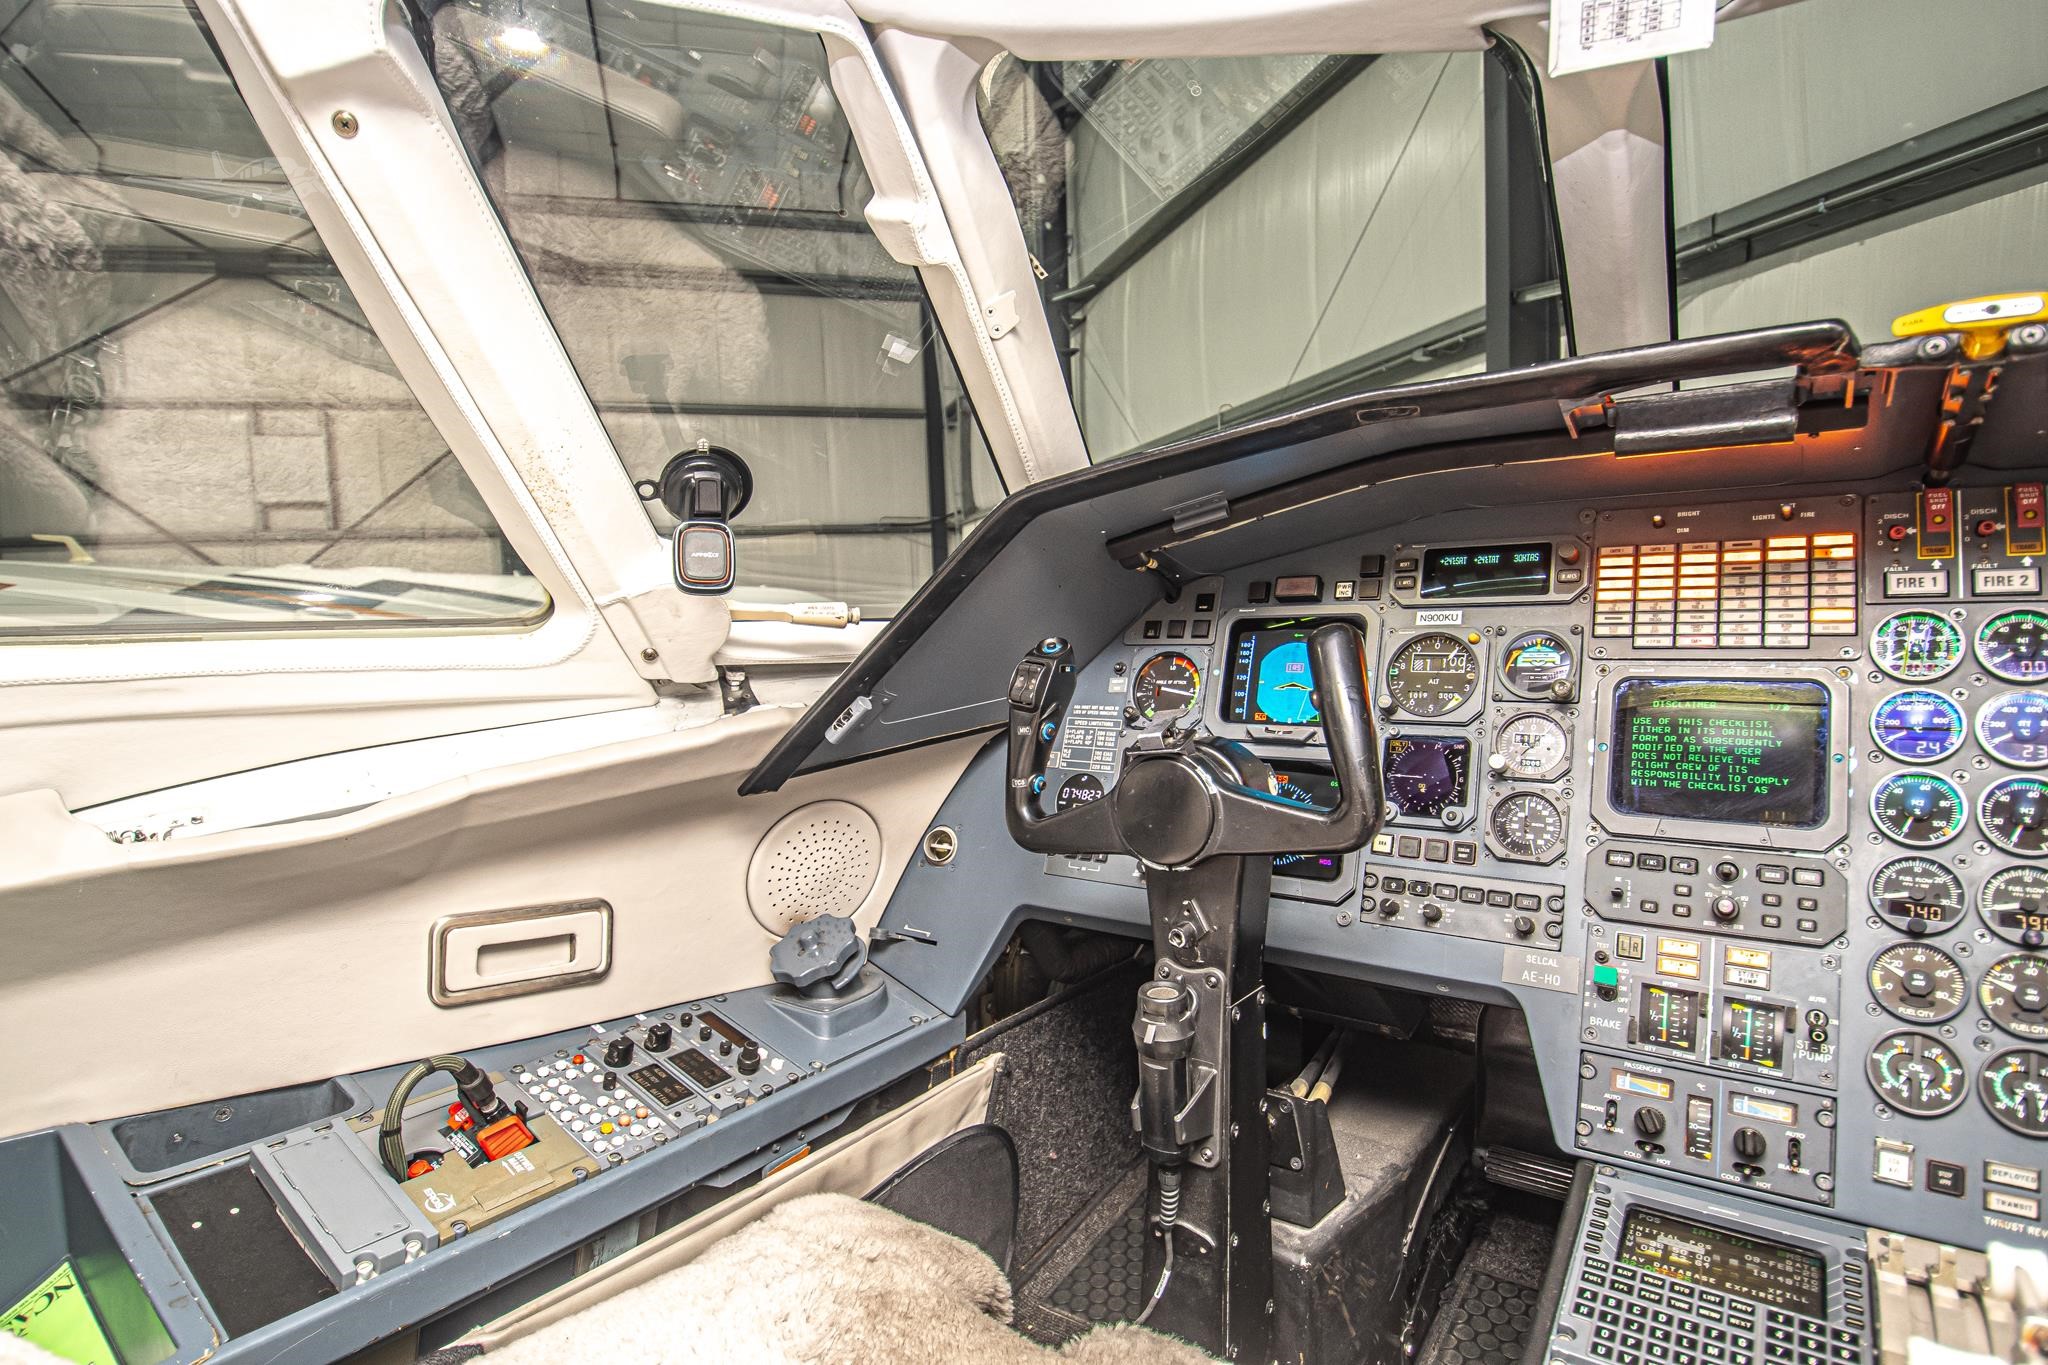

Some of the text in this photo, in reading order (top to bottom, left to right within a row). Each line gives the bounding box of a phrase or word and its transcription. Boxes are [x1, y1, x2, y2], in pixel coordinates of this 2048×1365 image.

[1896, 577, 1937, 588] FIRE 1
[1984, 575, 2028, 586] FIRE 2
[1420, 614, 1458, 622] N900KU
[1652, 700, 1716, 708] DISCLAIMER
[1710, 719, 1773, 728] CHECKLIST,
[1722, 728, 1775, 737] ORIGINAL
[1665, 735, 1677, 743] OR
[1703, 737, 1782, 747] SUBSEQUENTLY
[1632, 743, 1683, 752] MODIFIED
[1710, 746, 1728, 754] THE
[1735, 747, 1762, 755] USER
[1916, 741, 1940, 753] 24
[2023, 745, 2048, 757] 23
[1632, 752, 1761, 765] DOES NOT RELIEVE THE
[1632, 761, 1669, 769] FLIGHT
[1676, 763, 1702, 771] CREW
[1729, 765, 1747, 773] ITS
[1631, 770, 1789, 786] RESPONSIBILITY TO COMPLY
[1631, 779, 1768, 794] WITH THE CHECKLIST AS
[1905, 904, 1942, 921] 740
[1526, 955, 1560, 967] SELCAL
[1522, 970, 1560, 986] AE-HQ
[1898, 1008, 1916, 1017] FUEL
[1589, 1016, 1622, 1030] BRAKE
[2010, 1023, 2029, 1032] FUEL
[1798, 1050, 1833, 1063] PUMP
[1624, 1062, 1662, 1074] PASSENGER
[1753, 1086, 1776, 1096] CREW
[1603, 1093, 1621, 1101] AUTO
[1785, 1130, 1806, 1139] AUTO
[1623, 1150, 1641, 1159] COLD
[1656, 1158, 1671, 1166] HOT
[1721, 1172, 1740, 1181] COLD
[1992, 1169, 2037, 1183] DEPLOYED
[1755, 1180, 1772, 1189] HOT
[1995, 1198, 2033, 1212] TRANSIT
[1639, 1214, 1661, 1224] POS
[1984, 1216, 2024, 1233] THRUST
[1630, 1224, 1678, 1239] INITIAL
[1587, 1260, 1606, 1269] DATA
[1785, 1259, 1818, 1272] DATE
[1584, 1274, 1602, 1283] FUEL
[1617, 1269, 1633, 1277] NAV
[1622, 1253, 1783, 1303] NAV DATABASE EXPIRES
[1753, 1268, 1818, 1292] 13:48:22
[1614, 1283, 1628, 1292] FPL
[1641, 1291, 1660, 1300] PERF
[1702, 1293, 1720, 1303] LIST
[1670, 1300, 1690, 1309] TUNE
[1731, 1302, 1753, 1312] PREV
[1698, 1309, 1721, 1319] MENU
[1729, 1317, 1752, 1328] NEXT
